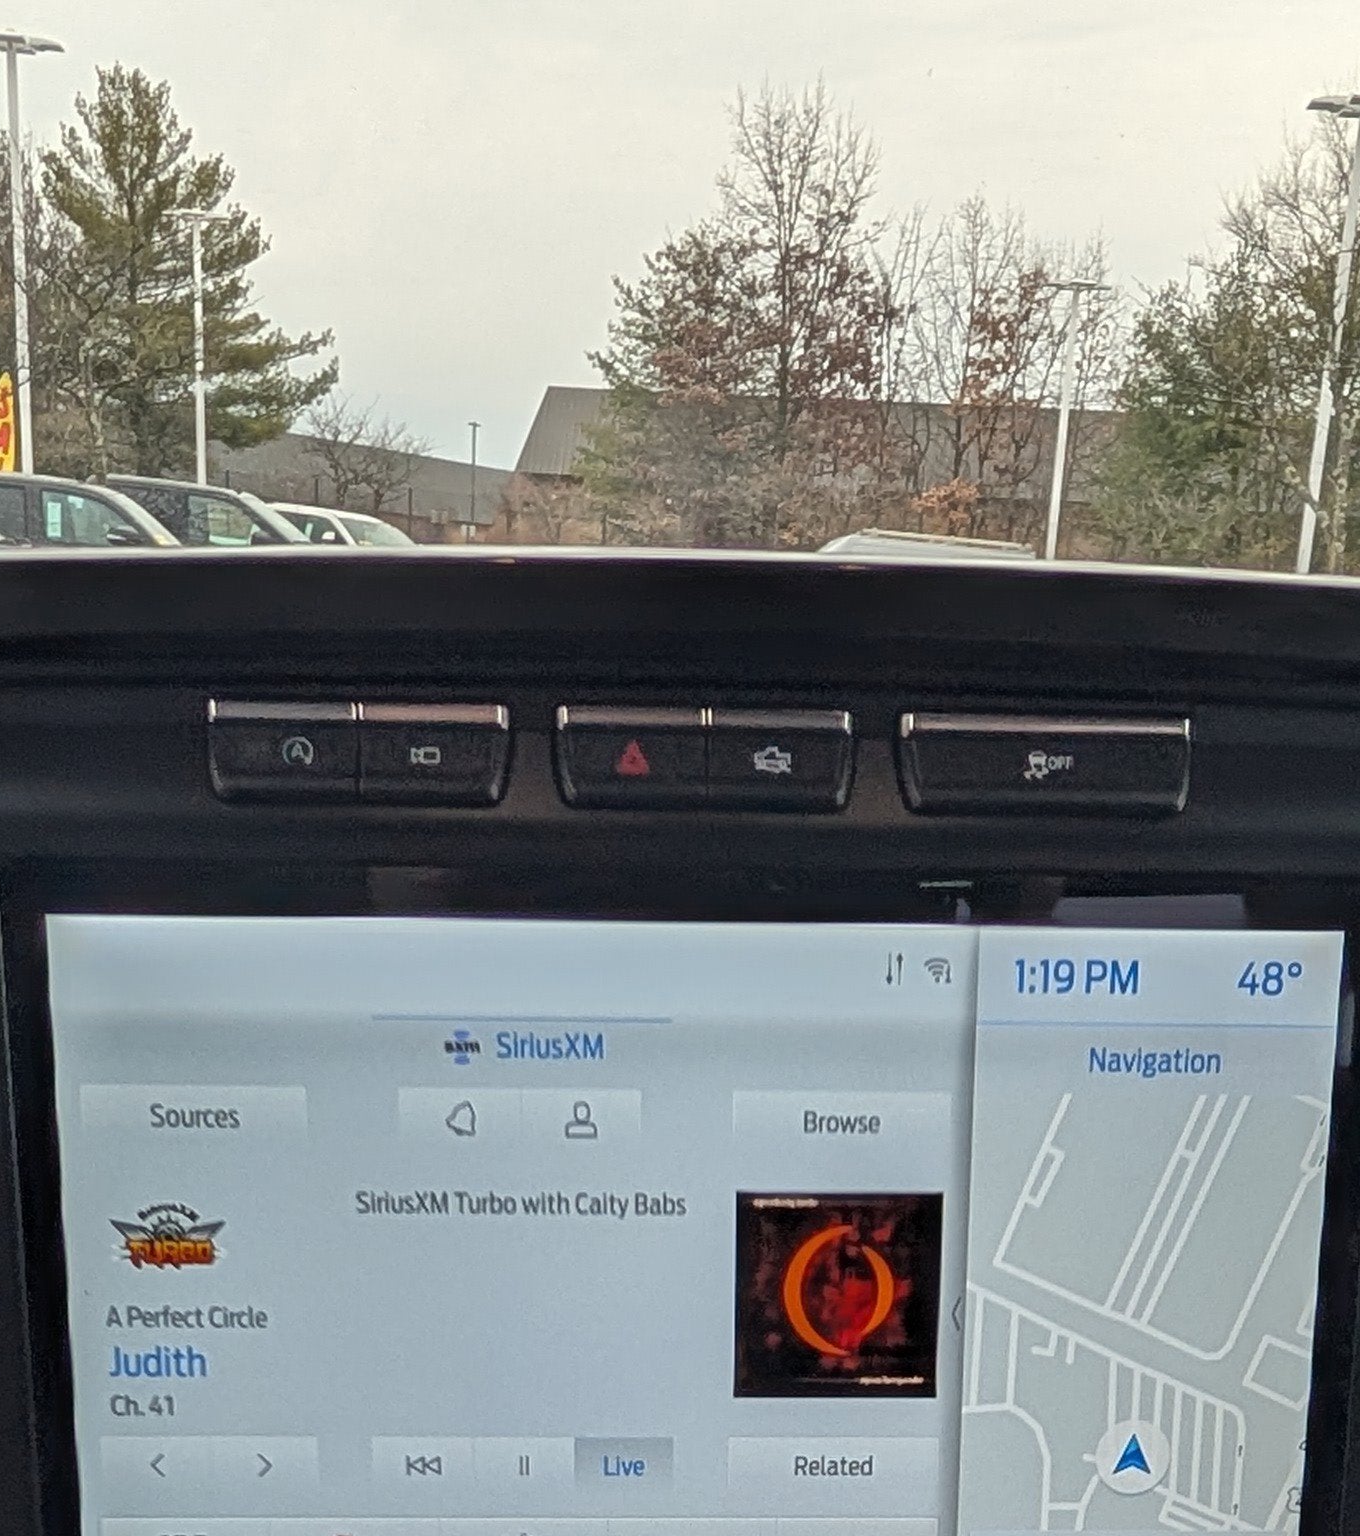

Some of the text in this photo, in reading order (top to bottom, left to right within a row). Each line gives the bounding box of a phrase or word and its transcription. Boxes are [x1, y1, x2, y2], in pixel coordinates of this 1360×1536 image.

[1014, 957, 1140, 995] 1:19 PM
[1237, 960, 1304, 996] 48°
[495, 1032, 605, 1061] SiriusXM
[1087, 1047, 1222, 1078] Navigation
[149, 1103, 241, 1130] Sources
[802, 1111, 881, 1135] Browse
[355, 1190, 687, 1221] SiriusXM Turbo with Caity Babs
[105, 1305, 269, 1329] A Perfect Circle
[108, 1345, 208, 1379] Judith
[109, 1394, 176, 1417] Ch. 41
[602, 1455, 646, 1477] Live
[792, 1455, 874, 1477] Related
